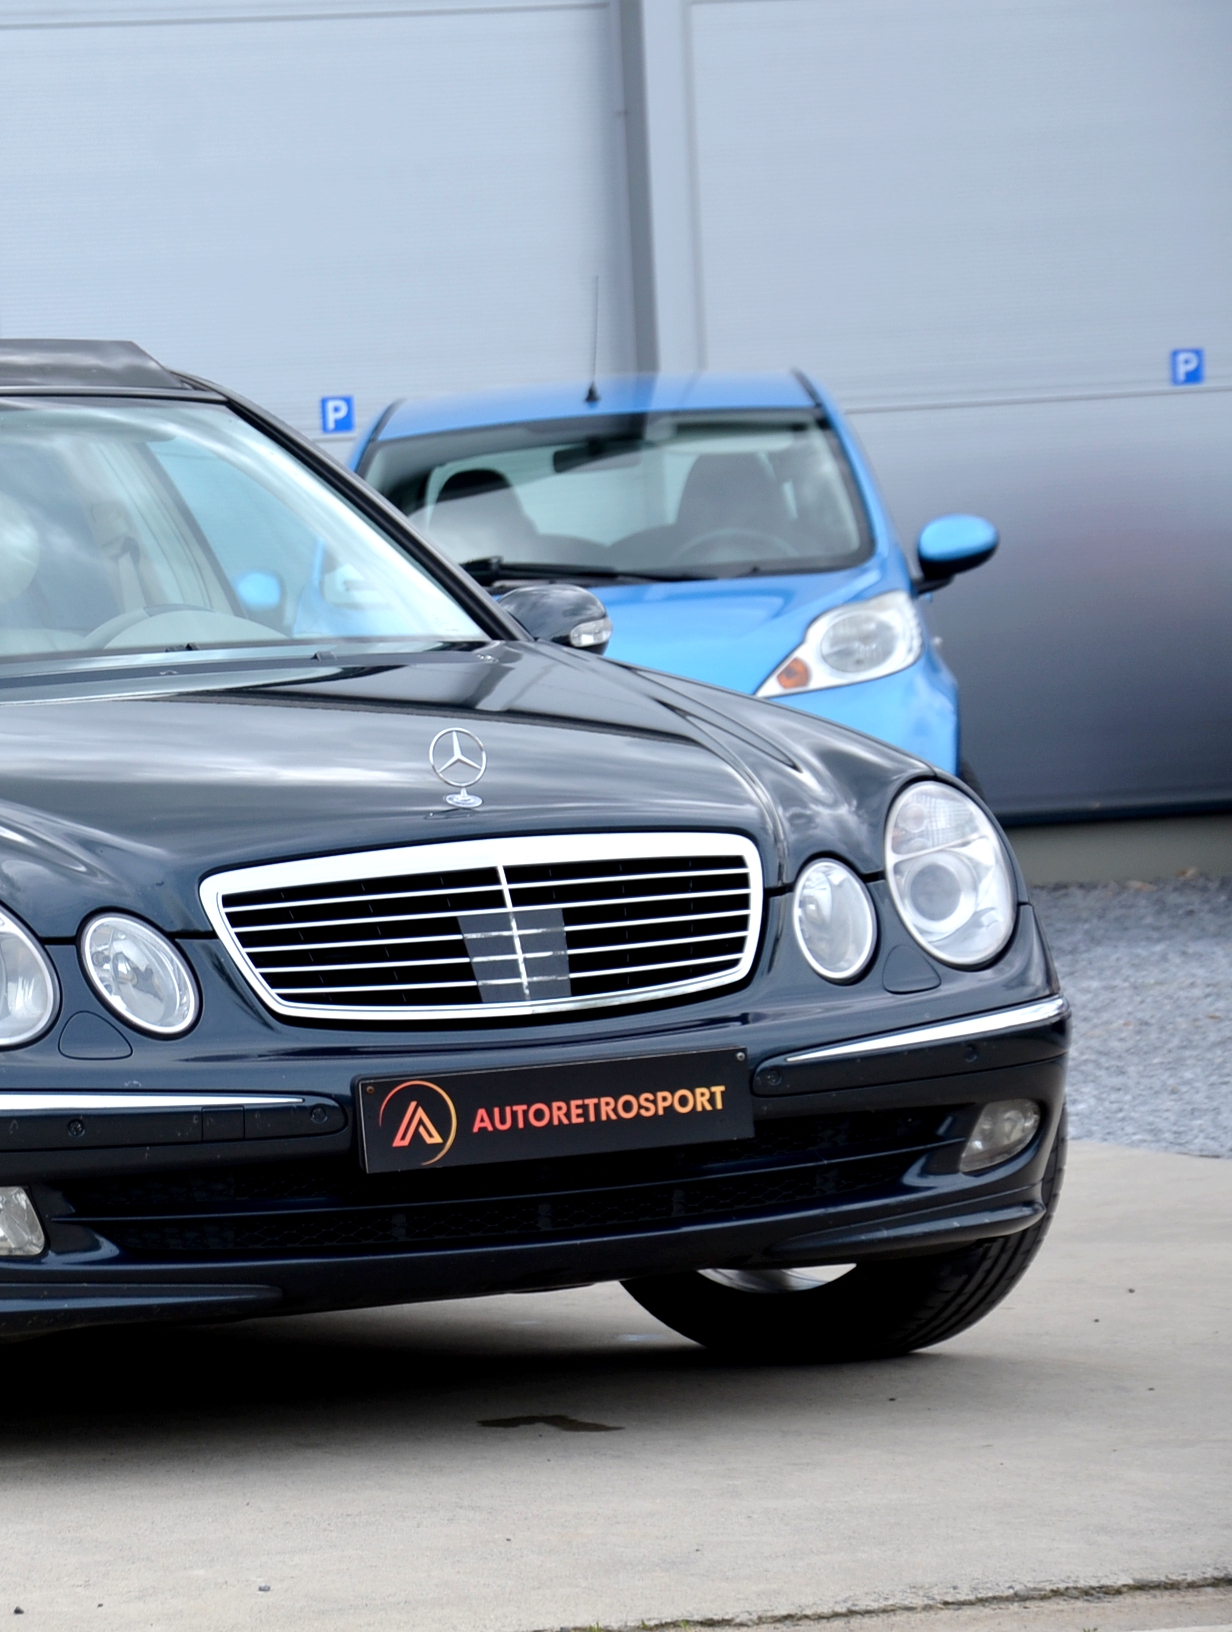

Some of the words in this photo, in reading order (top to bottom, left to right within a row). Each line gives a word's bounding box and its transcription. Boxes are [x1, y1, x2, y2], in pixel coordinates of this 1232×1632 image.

[1177, 351, 1199, 382] P
[326, 399, 349, 430] P
[471, 1085, 727, 1134] AUTORETROSPORT
